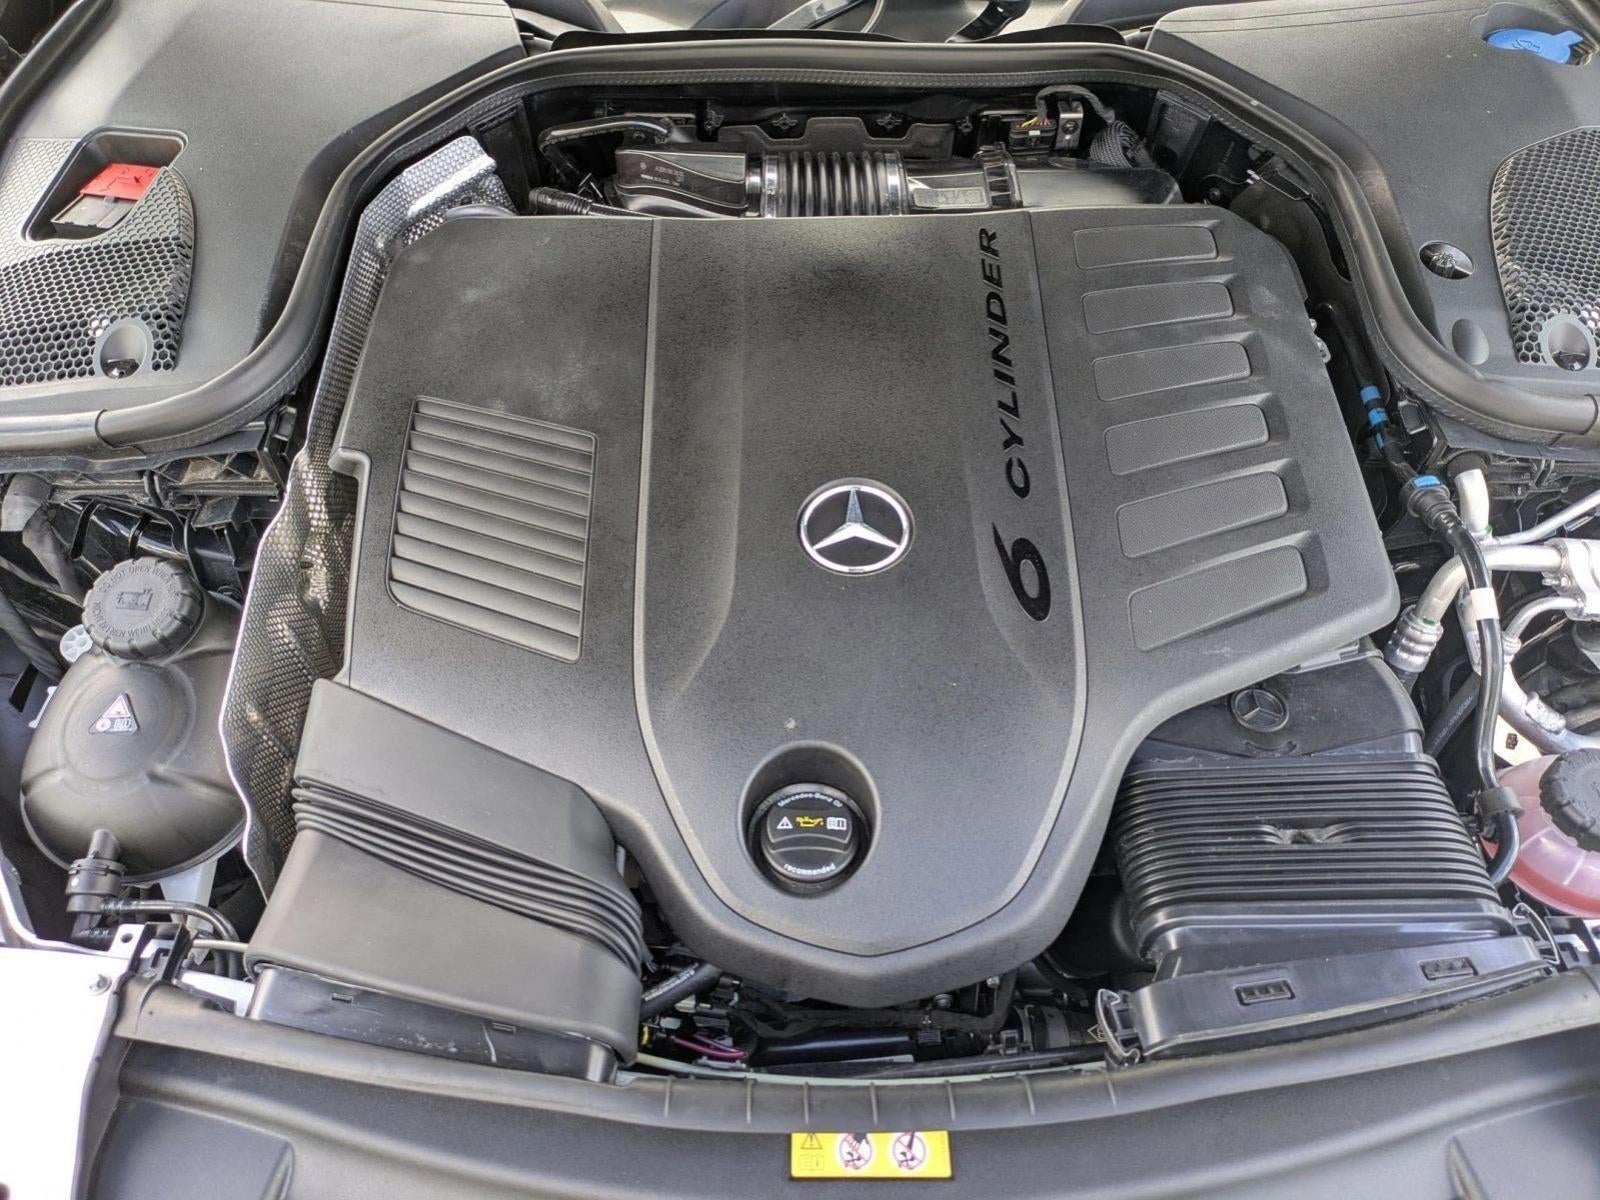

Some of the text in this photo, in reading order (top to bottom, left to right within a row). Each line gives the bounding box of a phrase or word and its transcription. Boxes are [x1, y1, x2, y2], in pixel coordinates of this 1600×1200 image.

[979, 227, 1051, 622] 6 CYLINDER
[128, 565, 150, 575] OPEN
[778, 792, 832, 806] Mercedes-Benz
[784, 863, 836, 875] recommended
